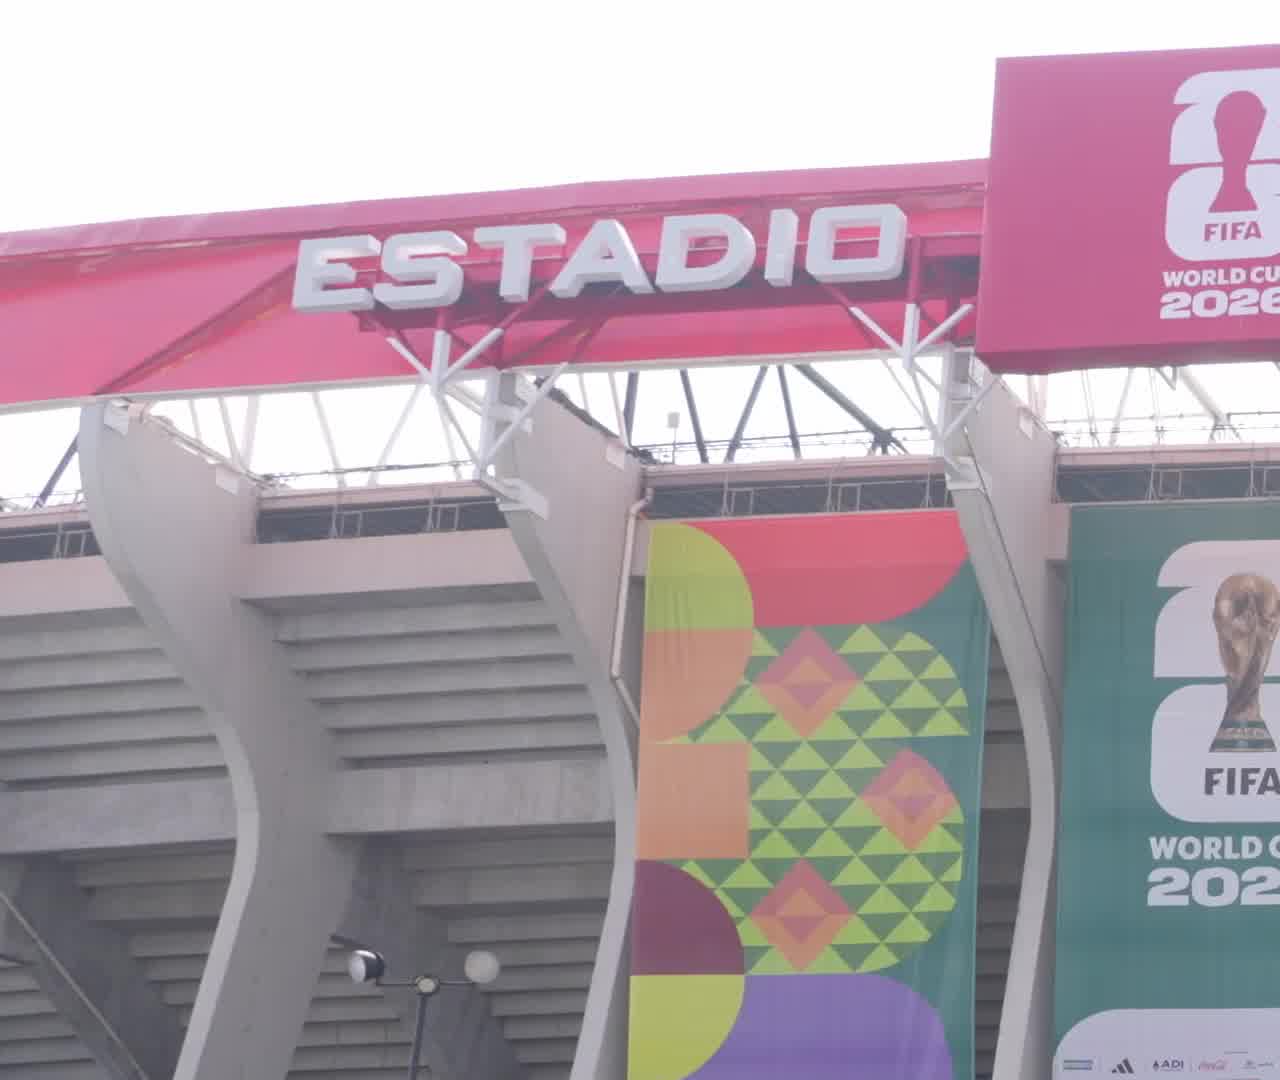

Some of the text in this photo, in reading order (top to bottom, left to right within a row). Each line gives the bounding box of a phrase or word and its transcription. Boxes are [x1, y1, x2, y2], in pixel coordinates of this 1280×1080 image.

[1202, 221, 1262, 243] FIFA
[290, 203, 908, 313] ESTADIO
[1162, 267, 1247, 288] WORLD
[1149, 835, 1263, 860] WORLD
